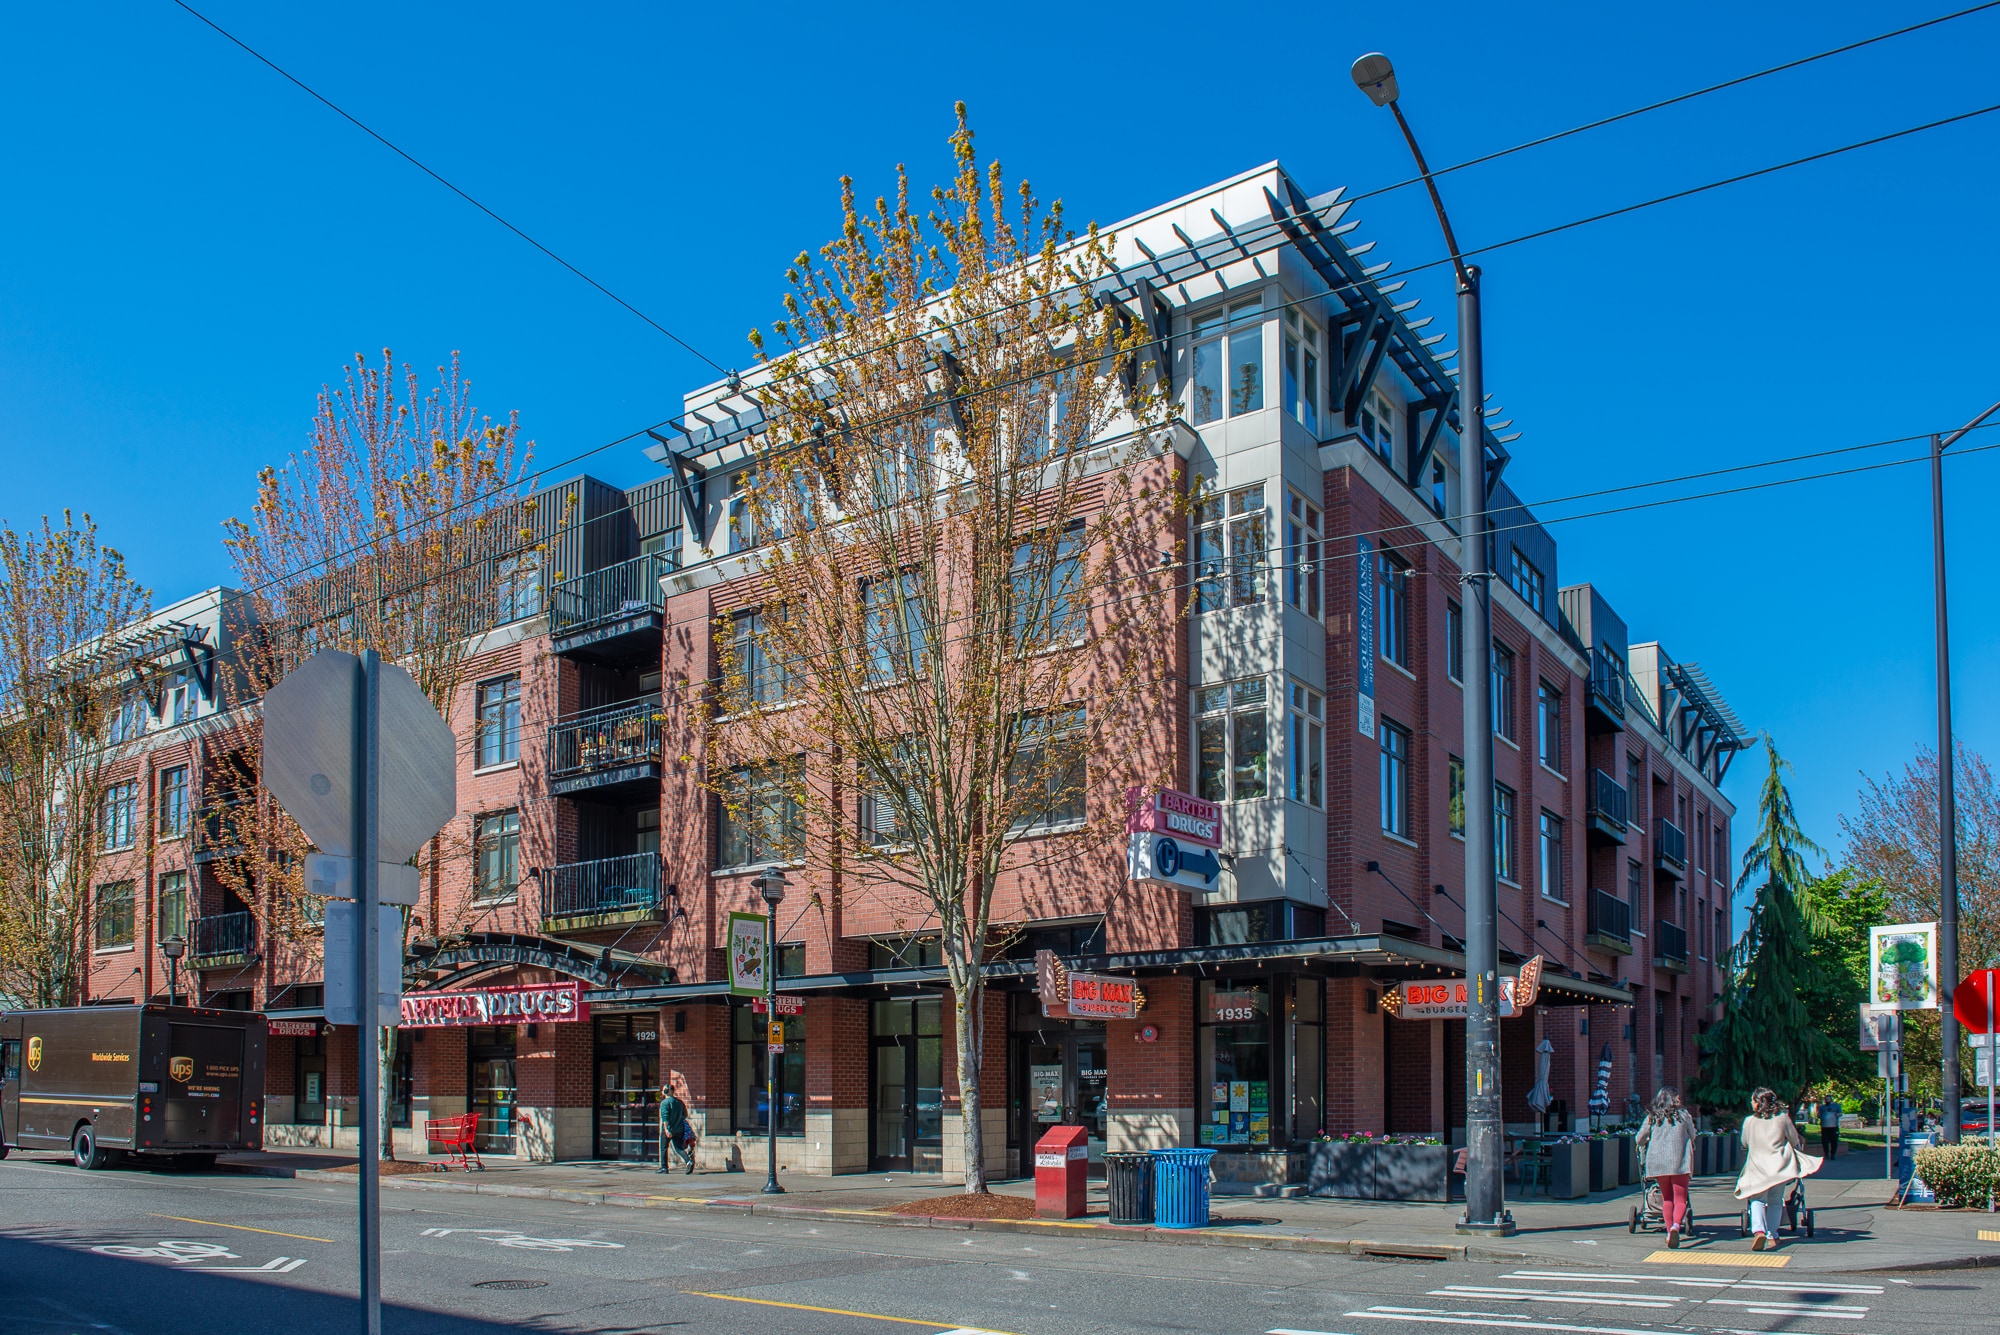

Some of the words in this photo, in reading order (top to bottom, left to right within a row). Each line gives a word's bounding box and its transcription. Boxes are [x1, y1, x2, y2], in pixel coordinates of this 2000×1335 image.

[1361, 605, 1369, 669] QUEEN
[1168, 814, 1213, 839] DRUGS
[1073, 980, 1100, 1000] BIG
[1101, 983, 1133, 1003] MAX
[1407, 985, 1449, 1004] BIG
[489, 991, 574, 1016] DRUGS
[1216, 1007, 1253, 1020] 1935
[636, 1031, 656, 1041] 1929
[30, 1047, 41, 1066] ups
[91, 1052, 112, 1061] Worldwide
[113, 1052, 129, 1061] Services
[172, 1064, 192, 1078] ups
